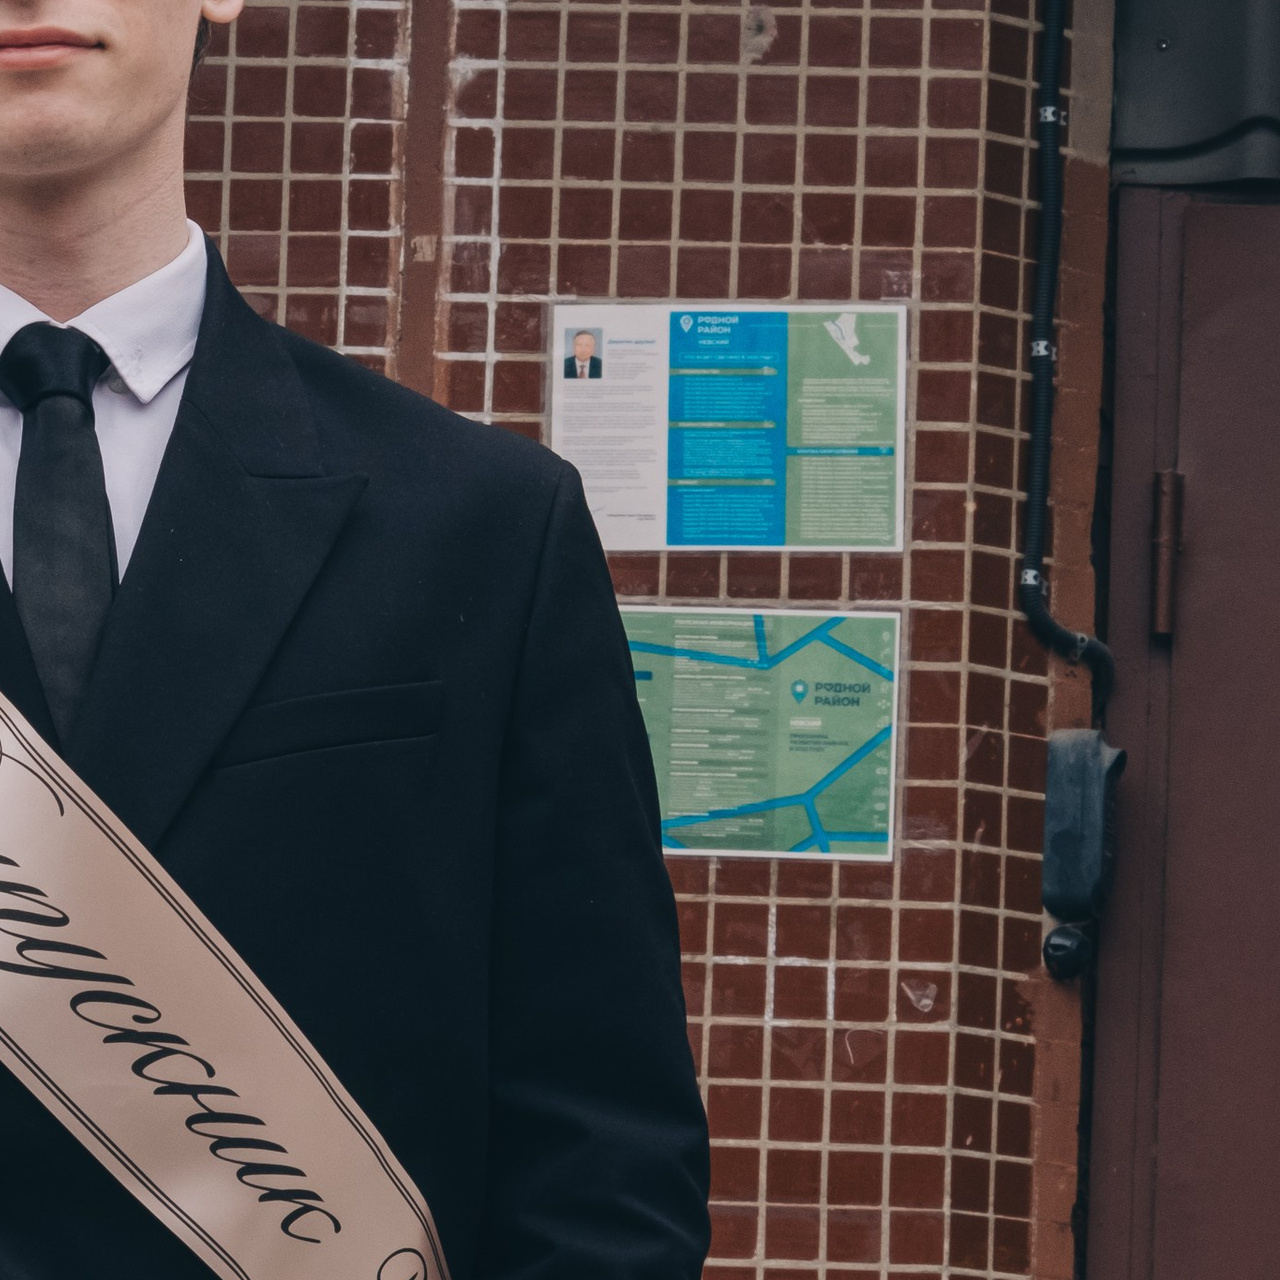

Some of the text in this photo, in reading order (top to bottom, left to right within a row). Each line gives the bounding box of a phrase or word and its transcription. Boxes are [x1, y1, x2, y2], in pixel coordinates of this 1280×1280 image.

[697, 315, 739, 324] РОДНОЙ
[697, 325, 731, 334] РАЙОН
[814, 682, 871, 694] РОДНОЙ
[814, 695, 860, 707] РАЙОН
